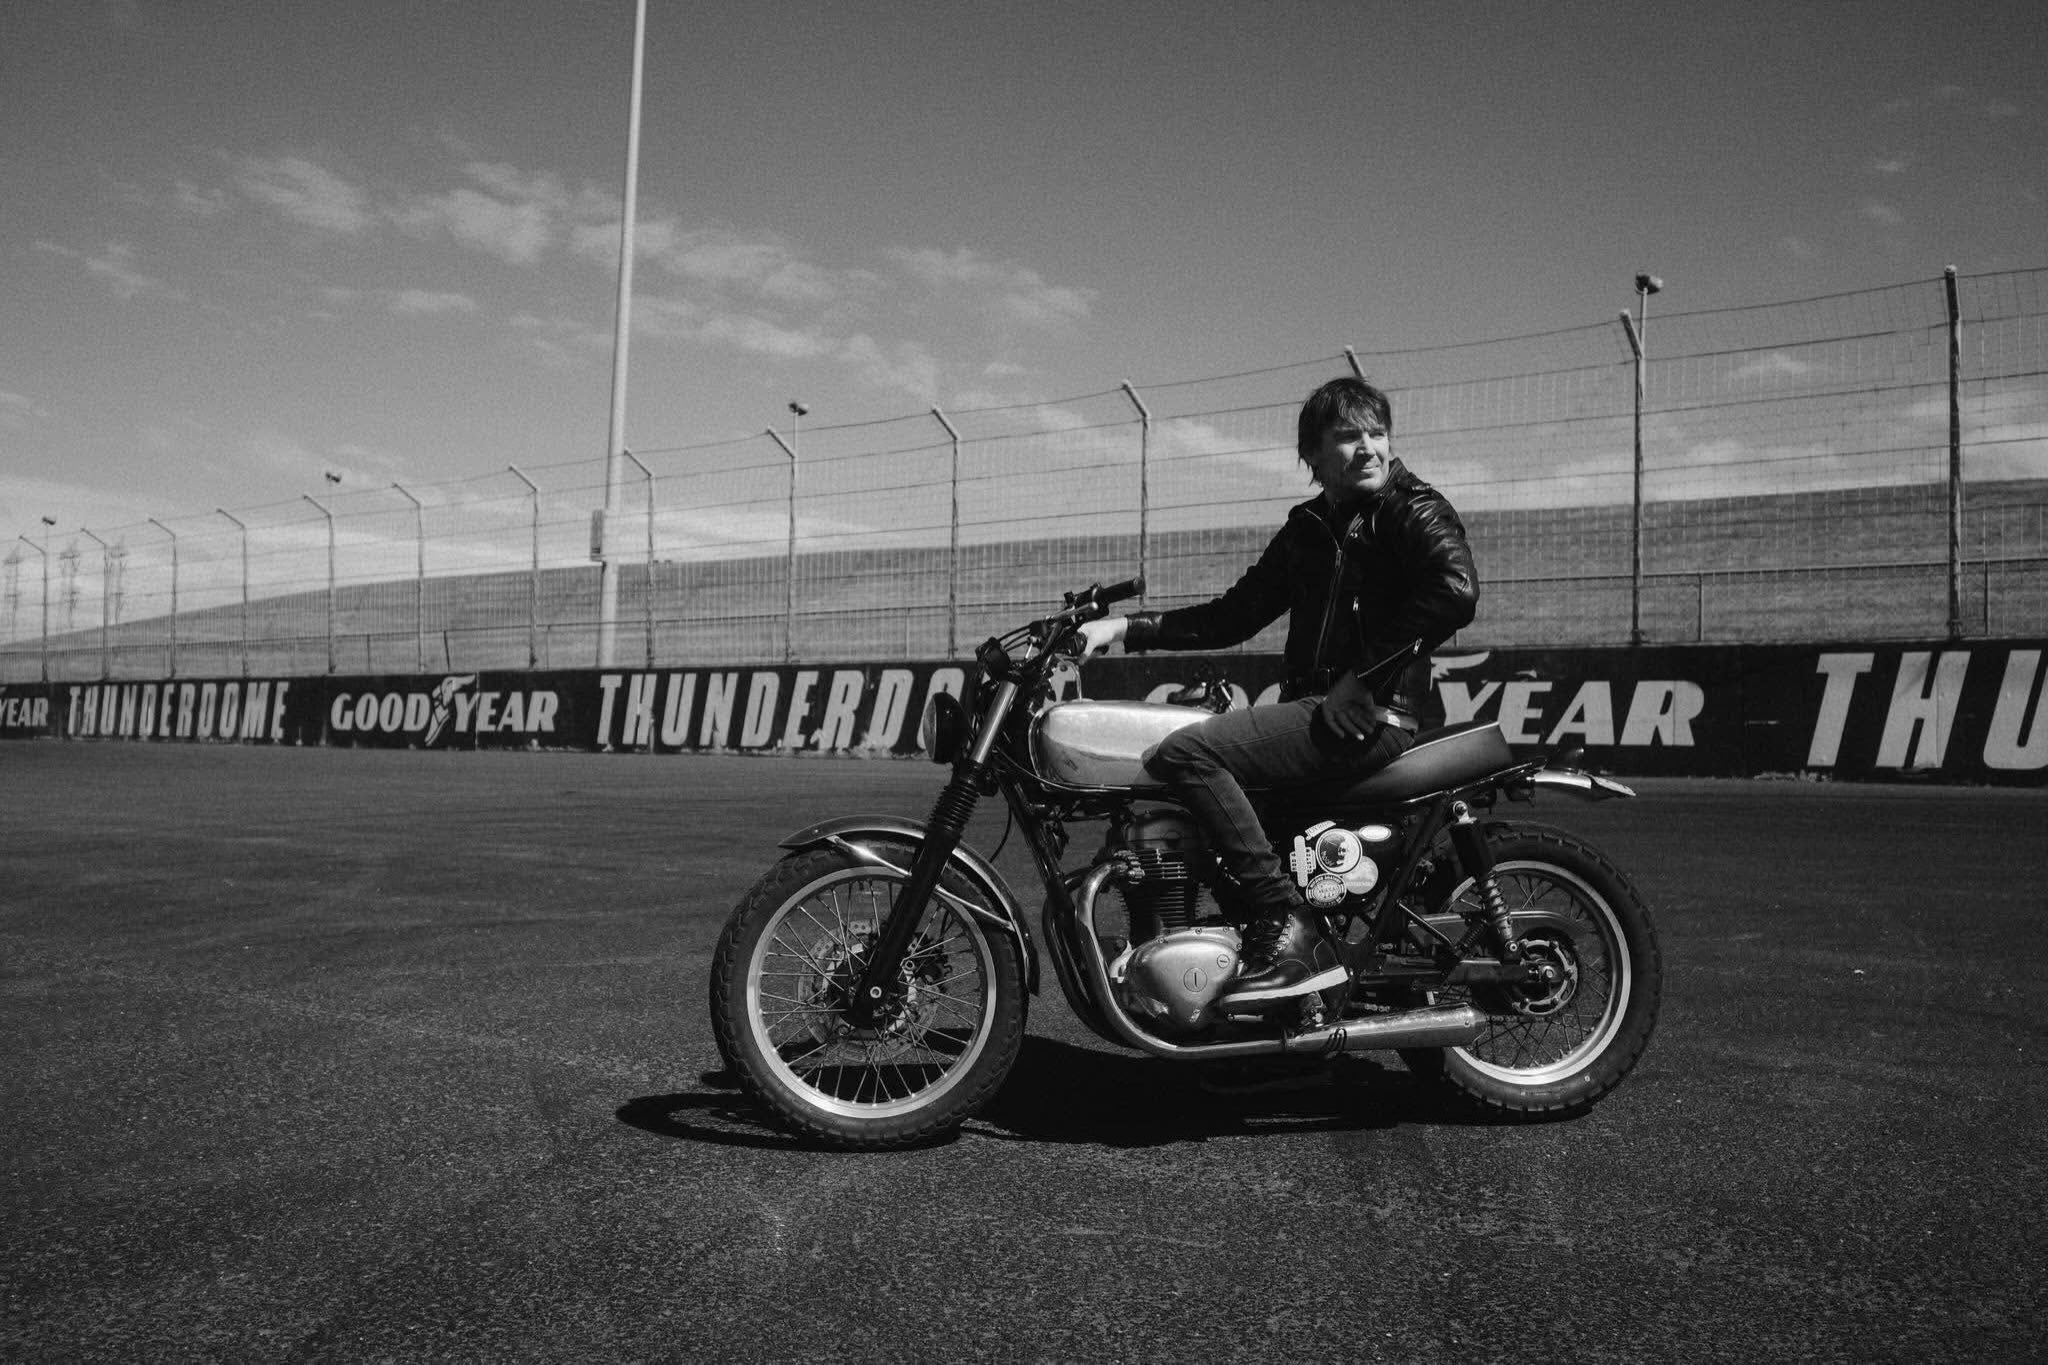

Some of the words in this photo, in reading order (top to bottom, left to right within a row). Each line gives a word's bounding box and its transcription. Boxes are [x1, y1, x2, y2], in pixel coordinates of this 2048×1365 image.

[67, 681, 290, 739] THUNDERDOME
[596, 662, 1086, 751] THUNDERDO
[1806, 649, 2048, 770] THU
